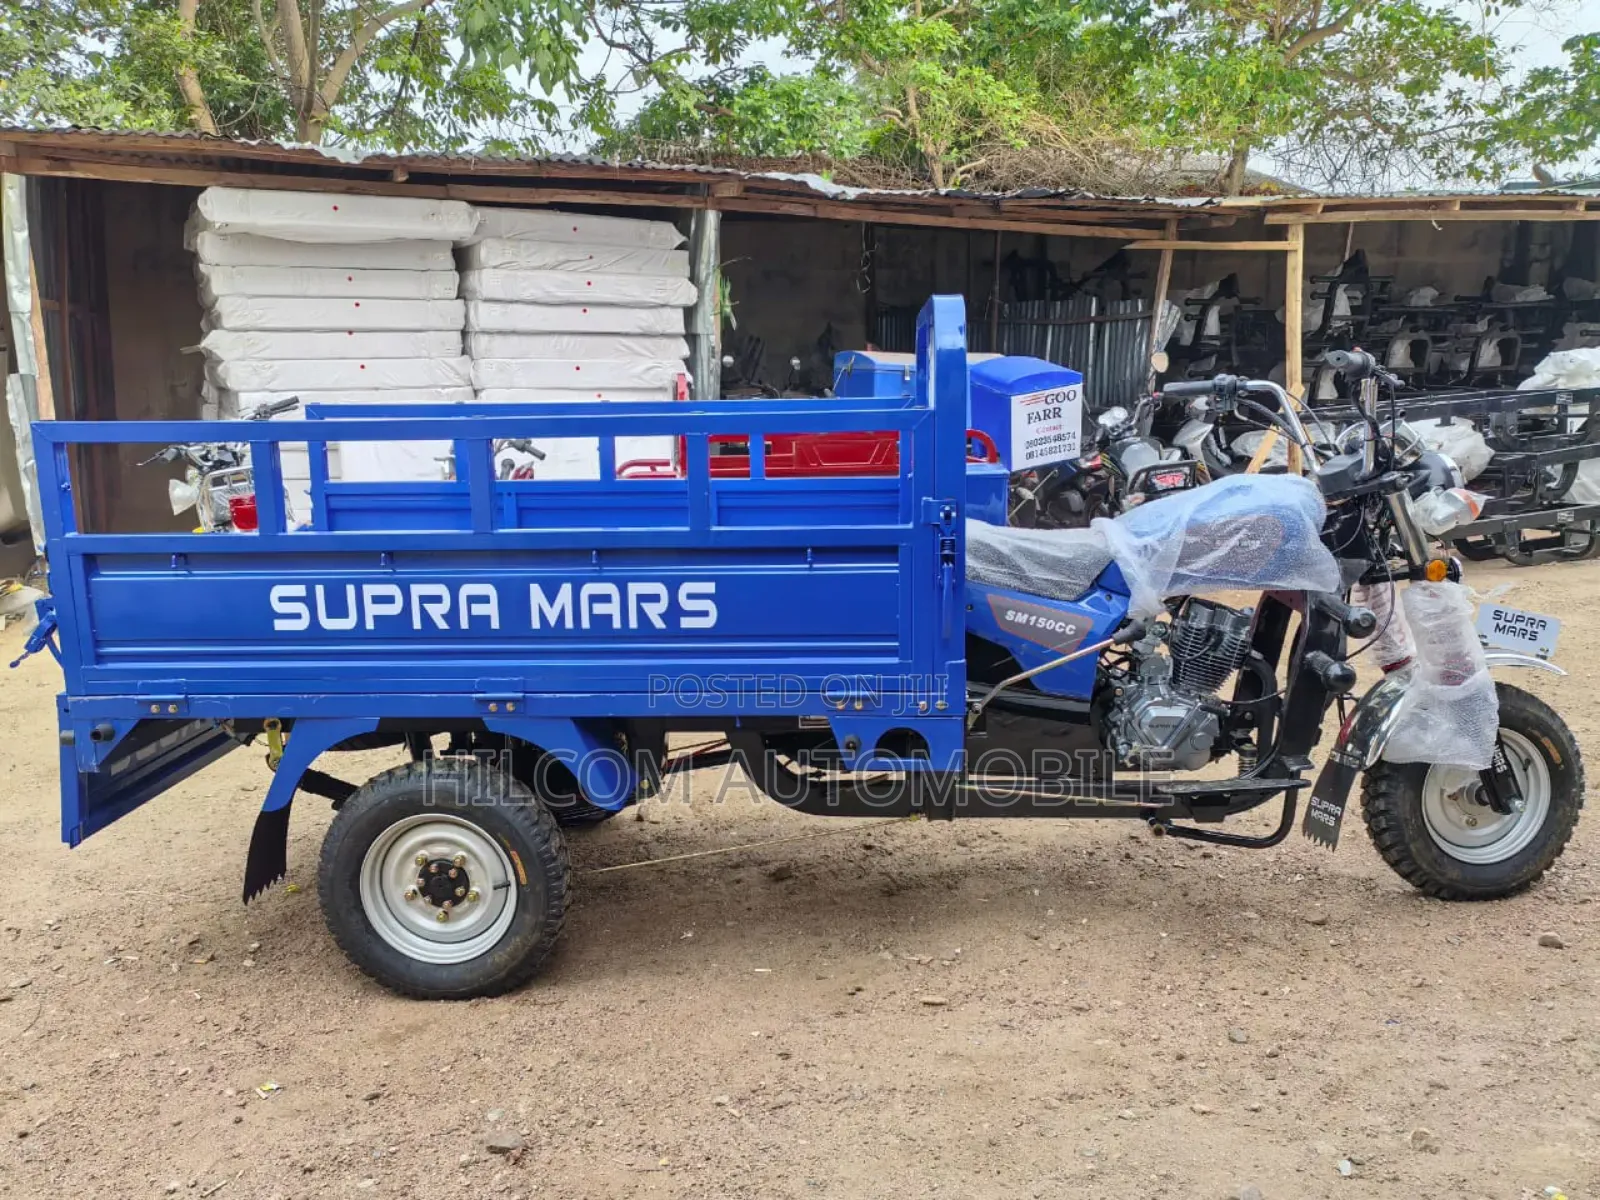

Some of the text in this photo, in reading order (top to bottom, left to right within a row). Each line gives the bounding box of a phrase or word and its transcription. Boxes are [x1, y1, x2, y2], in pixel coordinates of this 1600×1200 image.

[1044, 389, 1077, 406] GOO
[1026, 407, 1062, 425] FARR
[269, 582, 718, 631] SUPRA MARS
[1004, 609, 1077, 635] SM150CC
[1492, 609, 1548, 631] SUPRA
[1494, 622, 1540, 642] MARS
[1311, 796, 1342, 817] SUPRA
[1311, 808, 1336, 827] MARS
